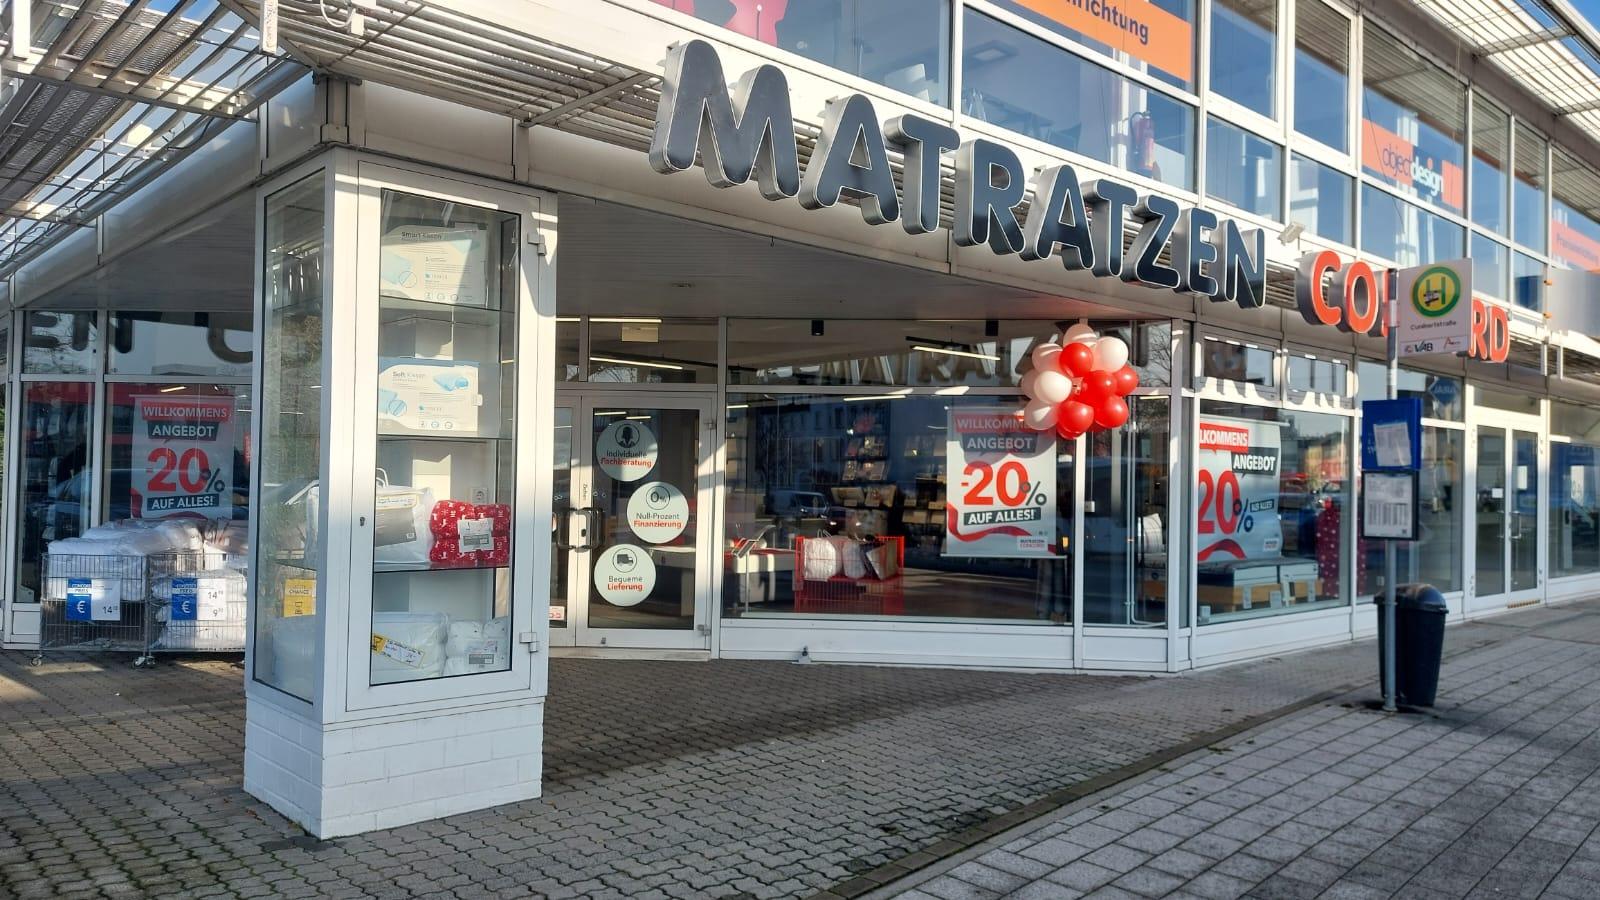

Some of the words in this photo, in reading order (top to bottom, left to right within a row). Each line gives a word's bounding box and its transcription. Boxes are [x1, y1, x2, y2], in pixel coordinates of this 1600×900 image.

[650, 39, 1265, 308] MATRATZEN
[1299, 250, 1510, 363] CORD
[143, 406, 228, 419] WILLKOMMENS
[152, 425, 215, 438] ANGEBOT
[966, 437, 1034, 449] ANGEBOT
[606, 449, 648, 458] Individuelle
[601, 457, 652, 468] Fachberatung
[1233, 454, 1276, 472] ANGEBOT
[960, 460, 1048, 507] -20%
[151, 498, 175, 511] AUF
[176, 496, 215, 510] ALLES!
[636, 512, 680, 520] Null-Prozent
[967, 512, 993, 525] AUF
[995, 509, 1035, 523] ALLES!
[633, 520, 682, 529] Finanzierung
[608, 575, 643, 584] Bequeme
[607, 583, 643, 592] Lieferung
[76, 600, 86, 614] €
[181, 600, 192, 614] €
